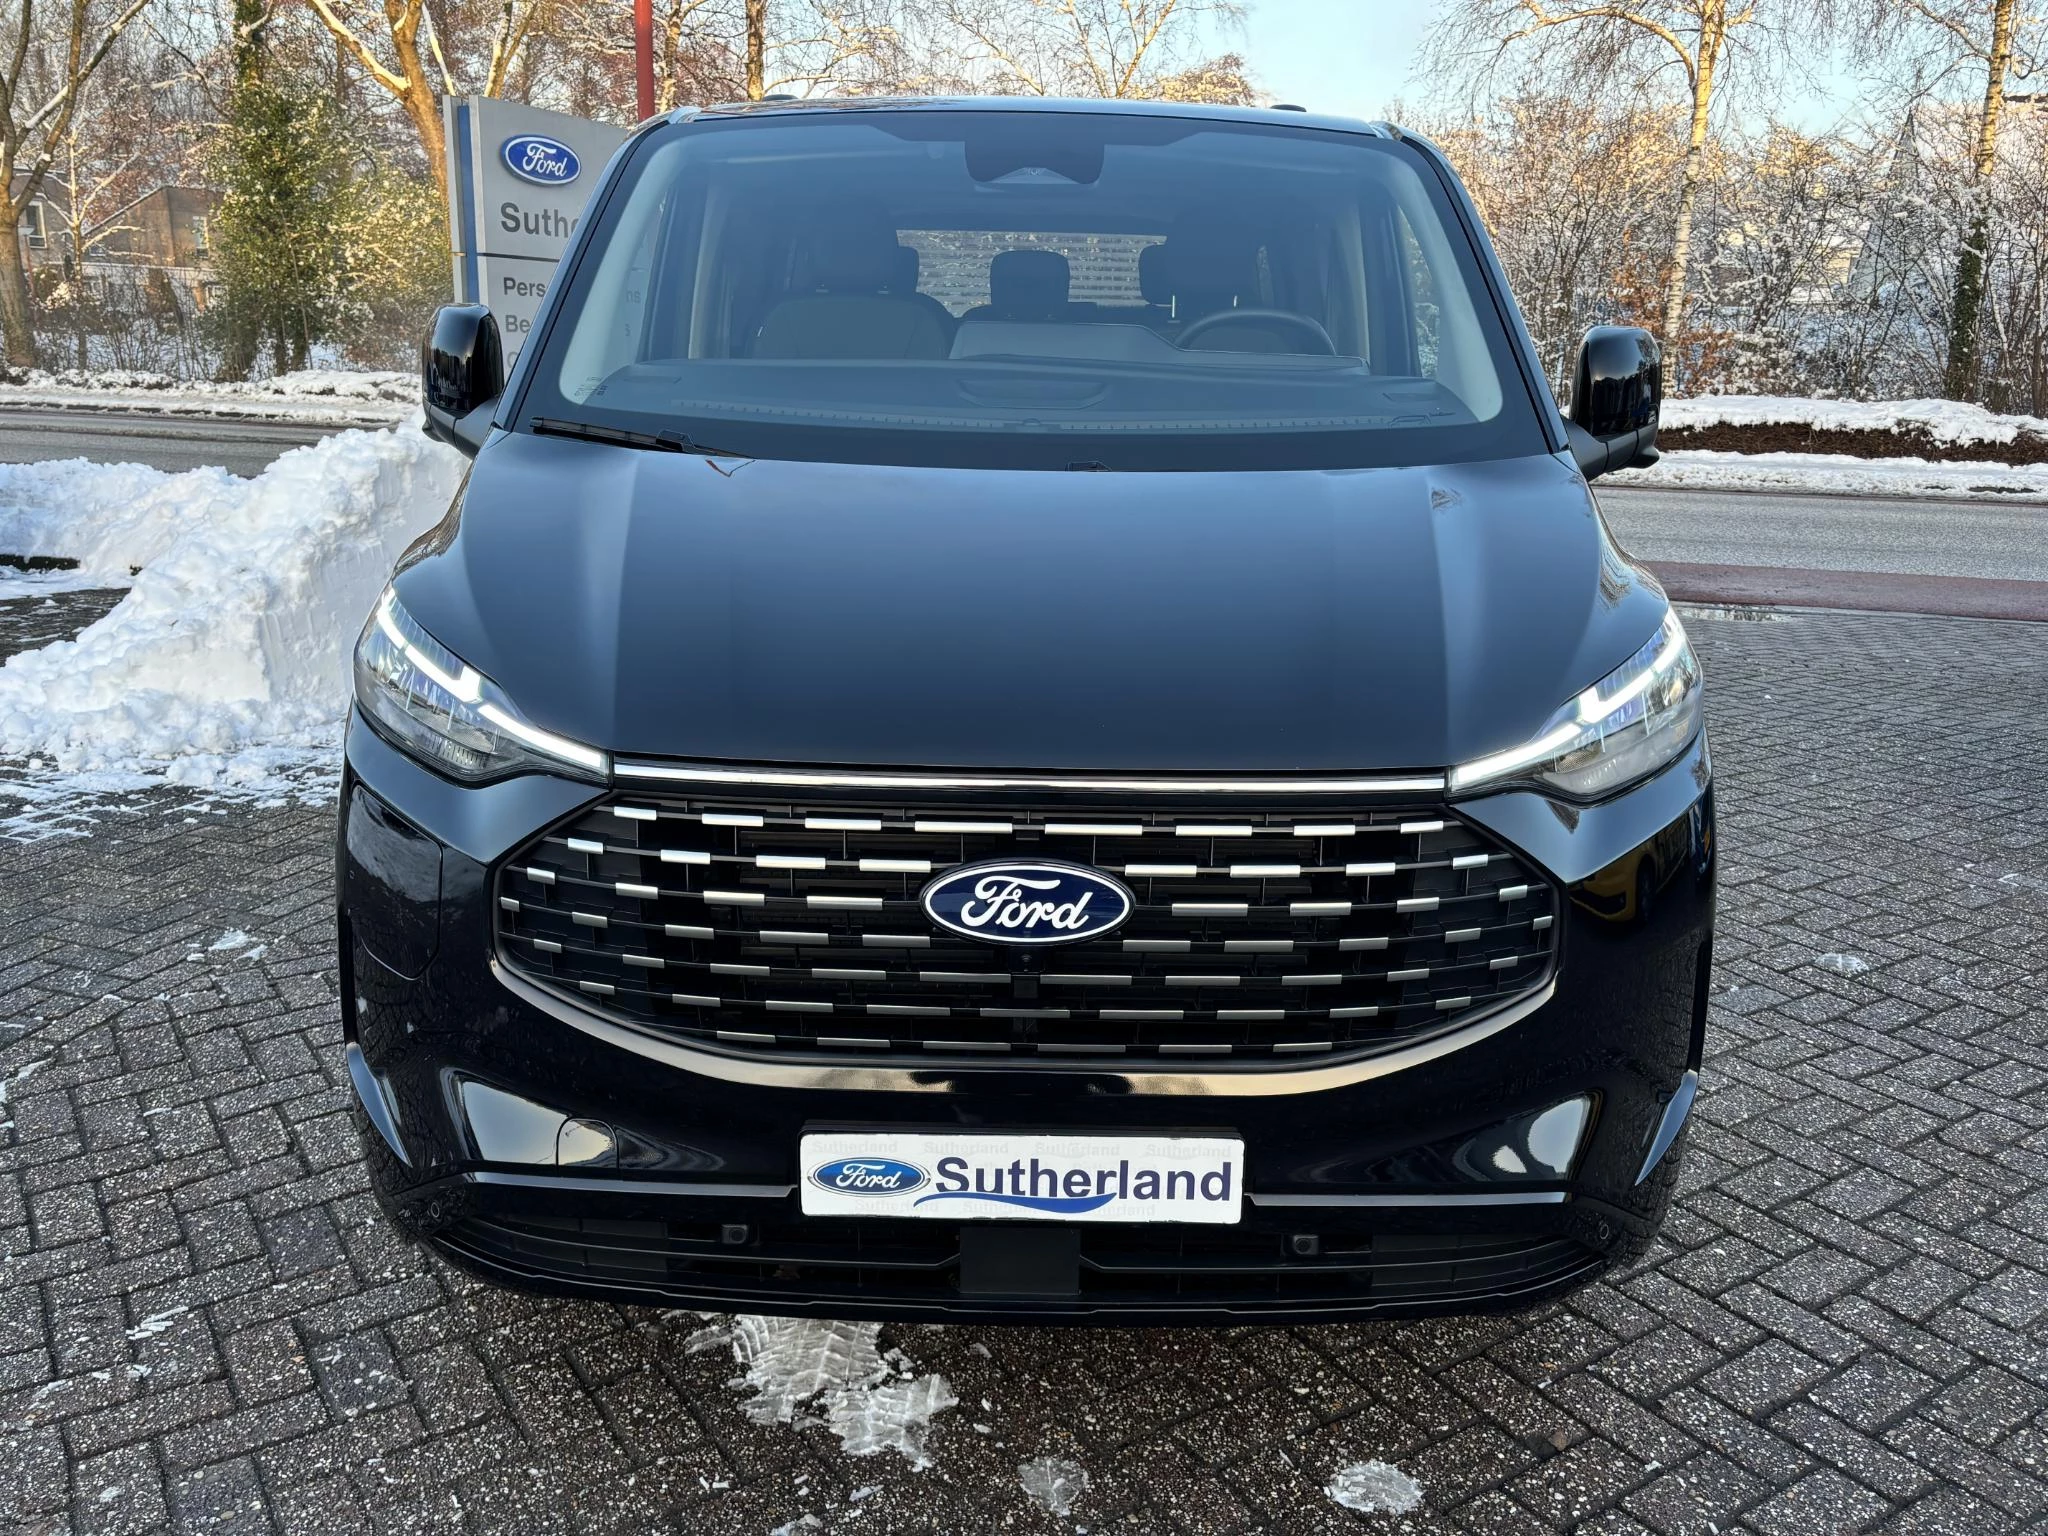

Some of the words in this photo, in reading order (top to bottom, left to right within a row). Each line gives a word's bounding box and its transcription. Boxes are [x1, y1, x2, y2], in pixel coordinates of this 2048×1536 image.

[522, 143, 568, 177] Ford
[960, 875, 1094, 930] Ford
[836, 1163, 902, 1189] Ford
[935, 1157, 1232, 1202] Sutherland
